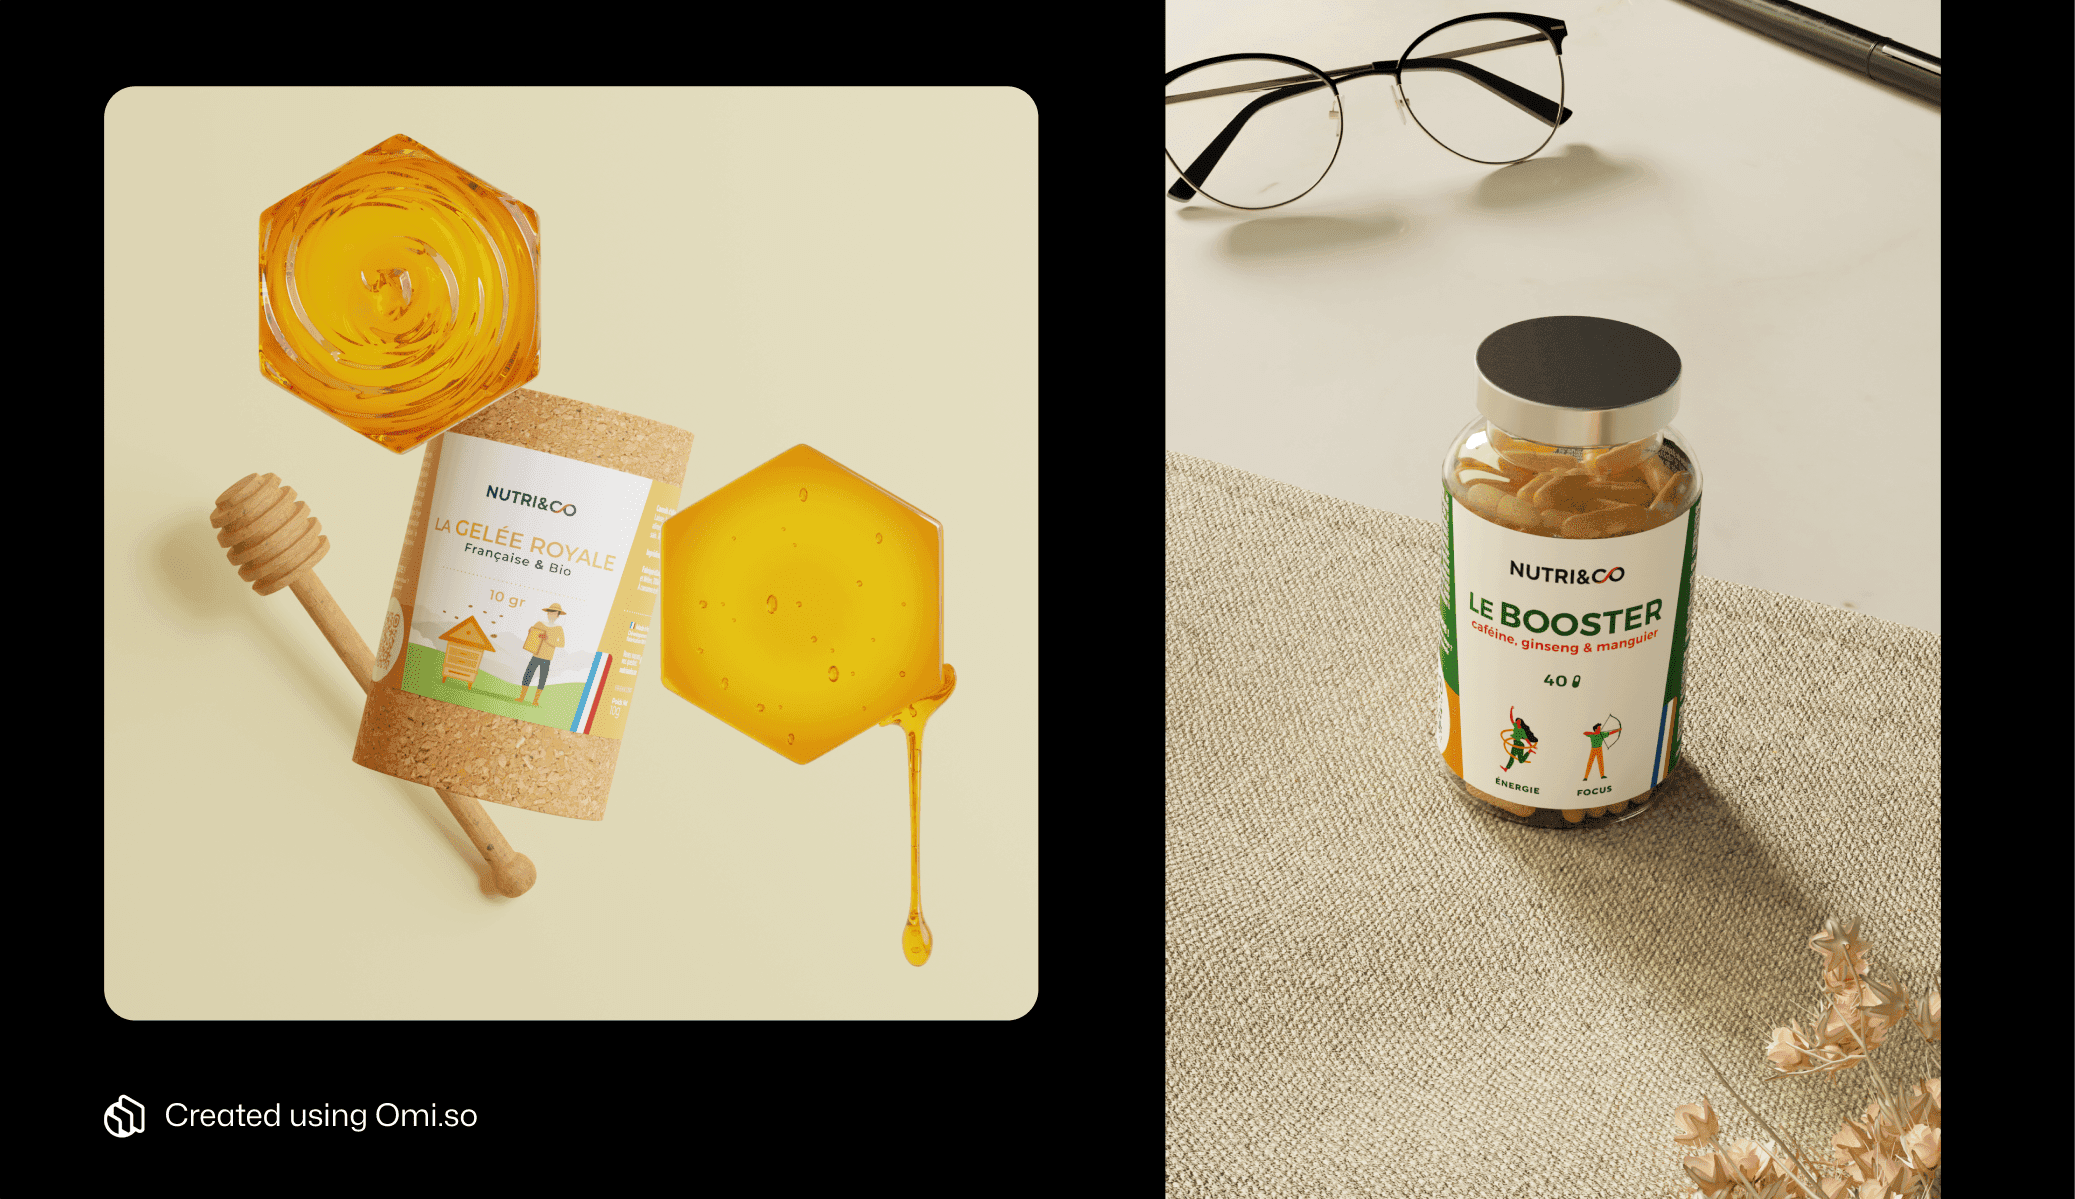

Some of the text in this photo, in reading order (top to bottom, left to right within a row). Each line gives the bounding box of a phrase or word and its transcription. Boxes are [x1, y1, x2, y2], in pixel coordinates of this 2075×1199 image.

[434, 517, 617, 572] LA GELÉE ROYALE
[463, 542, 572, 577] Française & Bio
[489, 588, 526, 609] 10 gr
[1469, 592, 1663, 637] LE BOOSTER
[1471, 620, 1659, 656] caféine, ginseng & manguier
[1543, 674, 1568, 687] 40
[1495, 776, 1540, 795] ÉNERGIE
[1576, 785, 1613, 797] FOCUS
